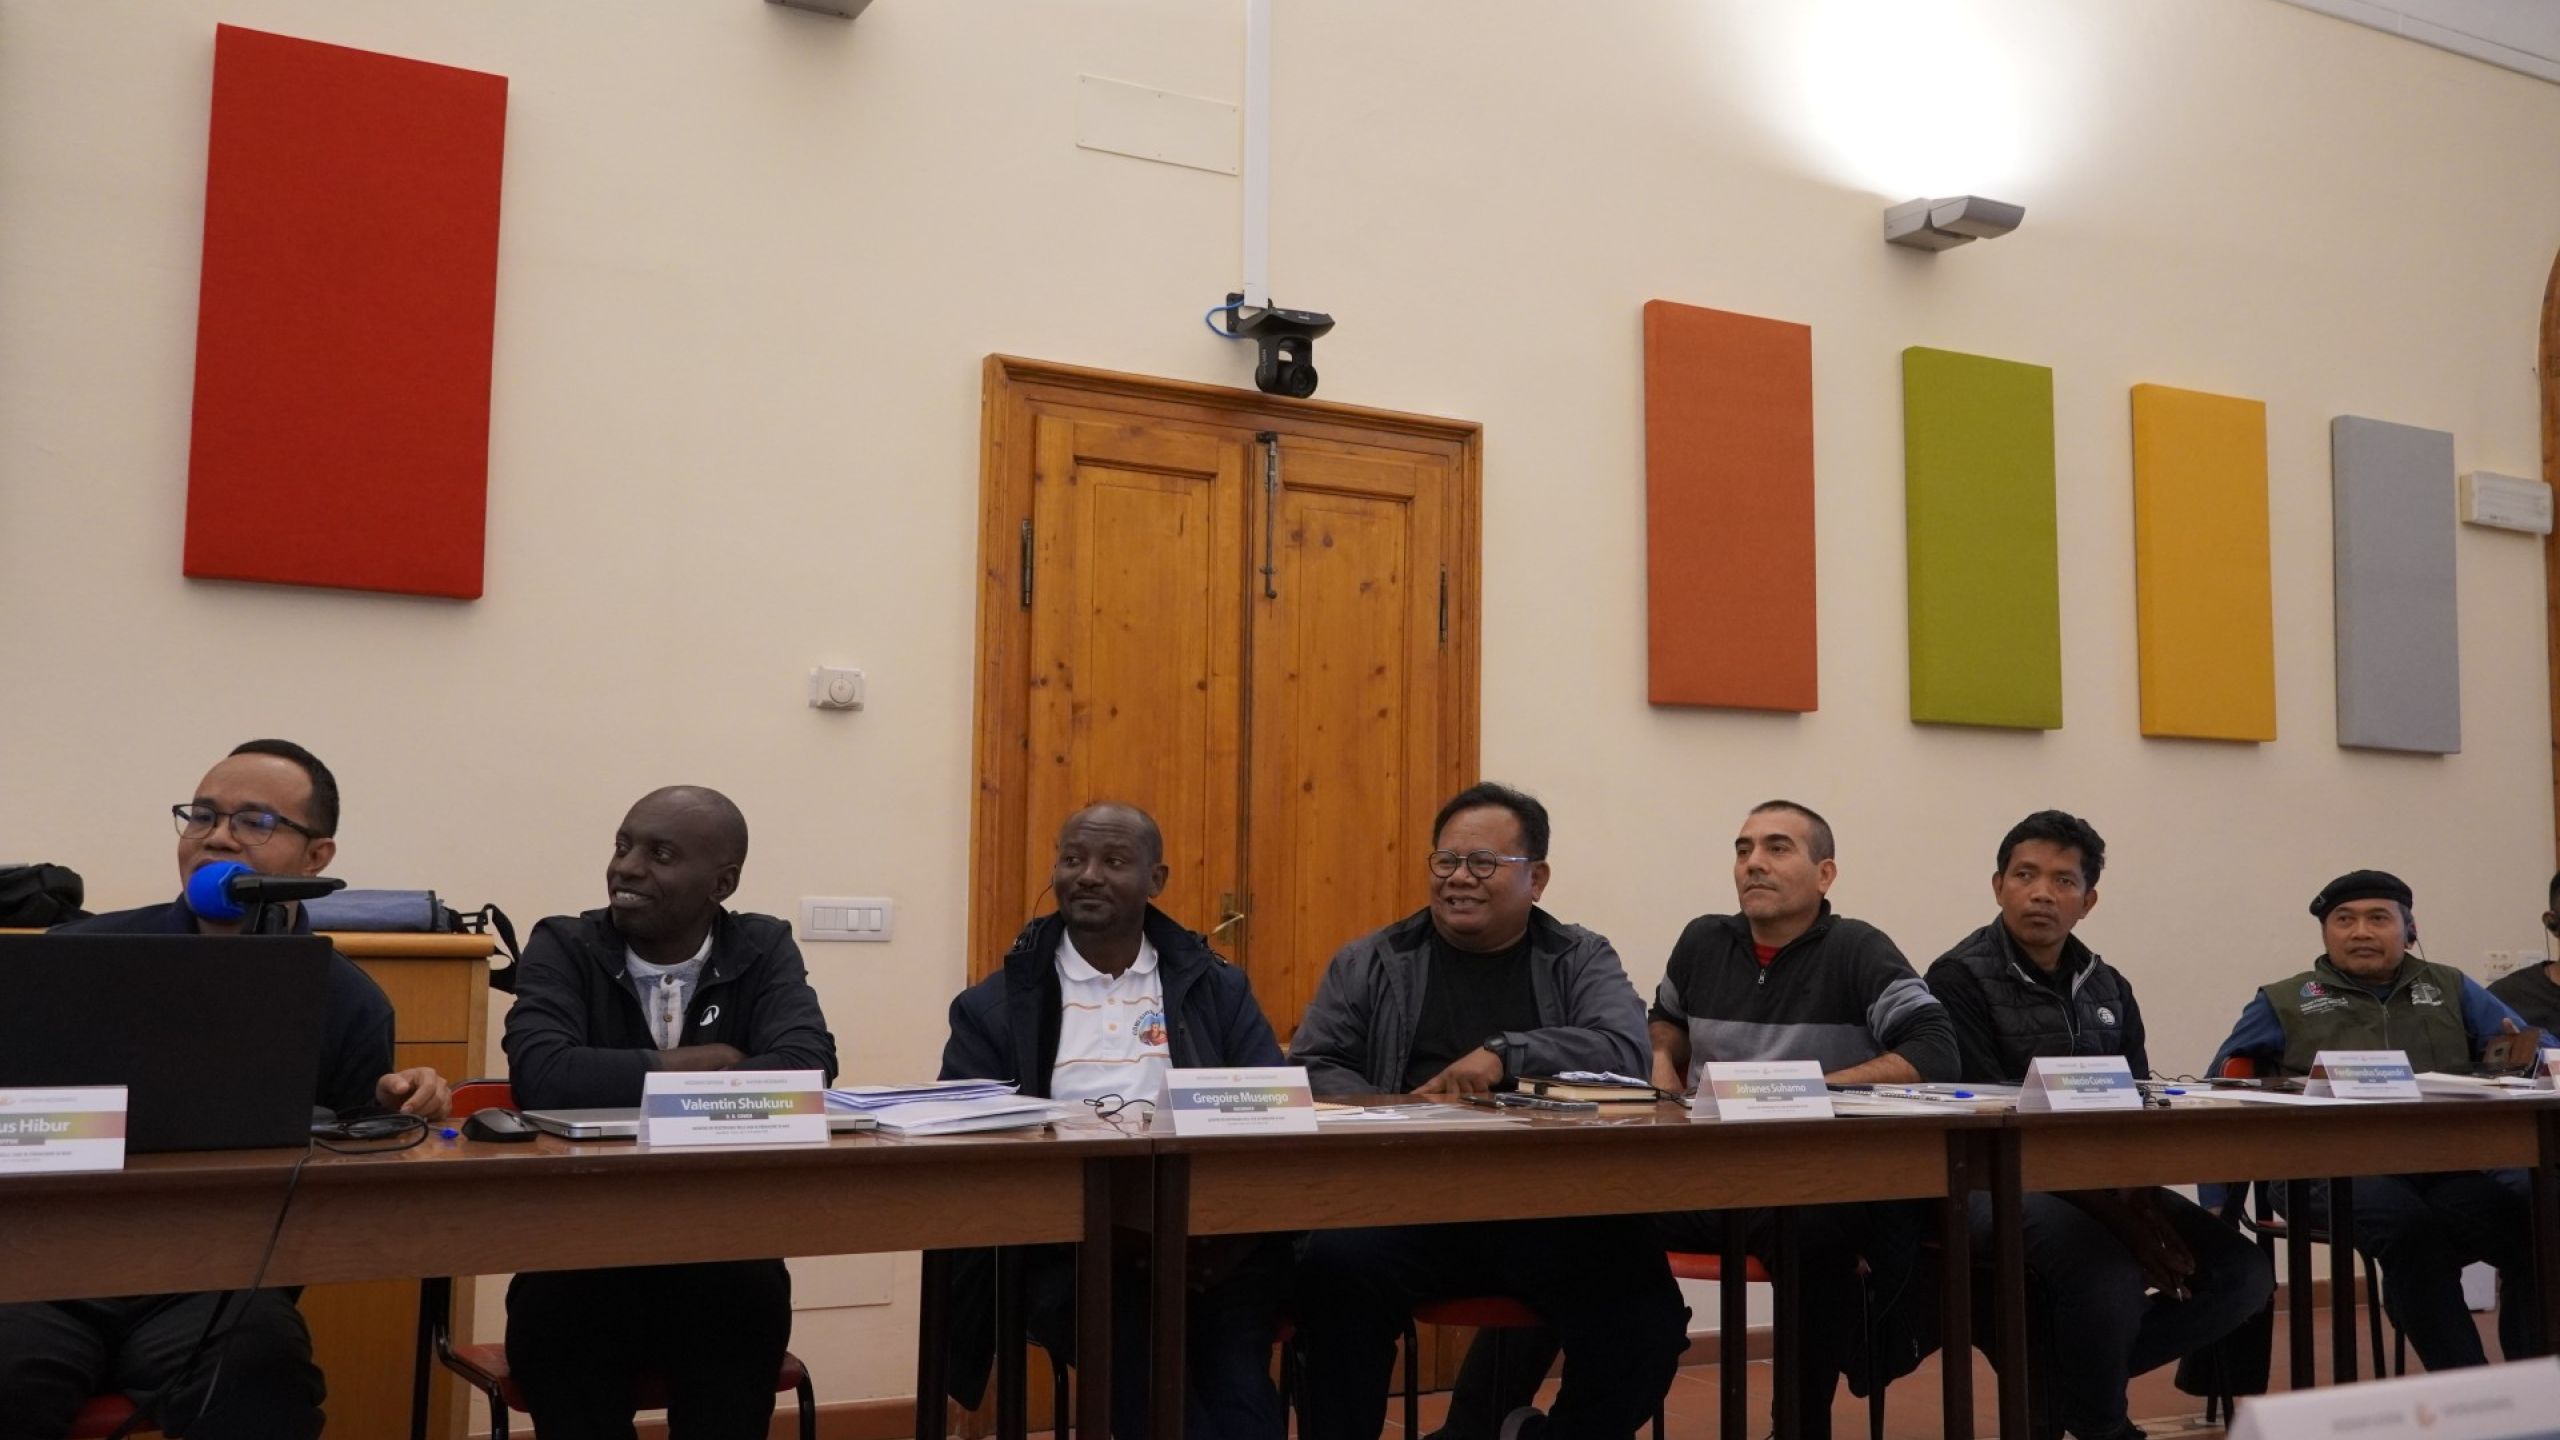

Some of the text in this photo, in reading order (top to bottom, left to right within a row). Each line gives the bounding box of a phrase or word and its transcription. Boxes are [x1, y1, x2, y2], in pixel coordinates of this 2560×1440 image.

[680, 1096, 794, 1111] Valentin Shukuru
[1193, 1091, 1289, 1106] Gregoire Musengo
[19, 1118, 71, 1133] Hibur
